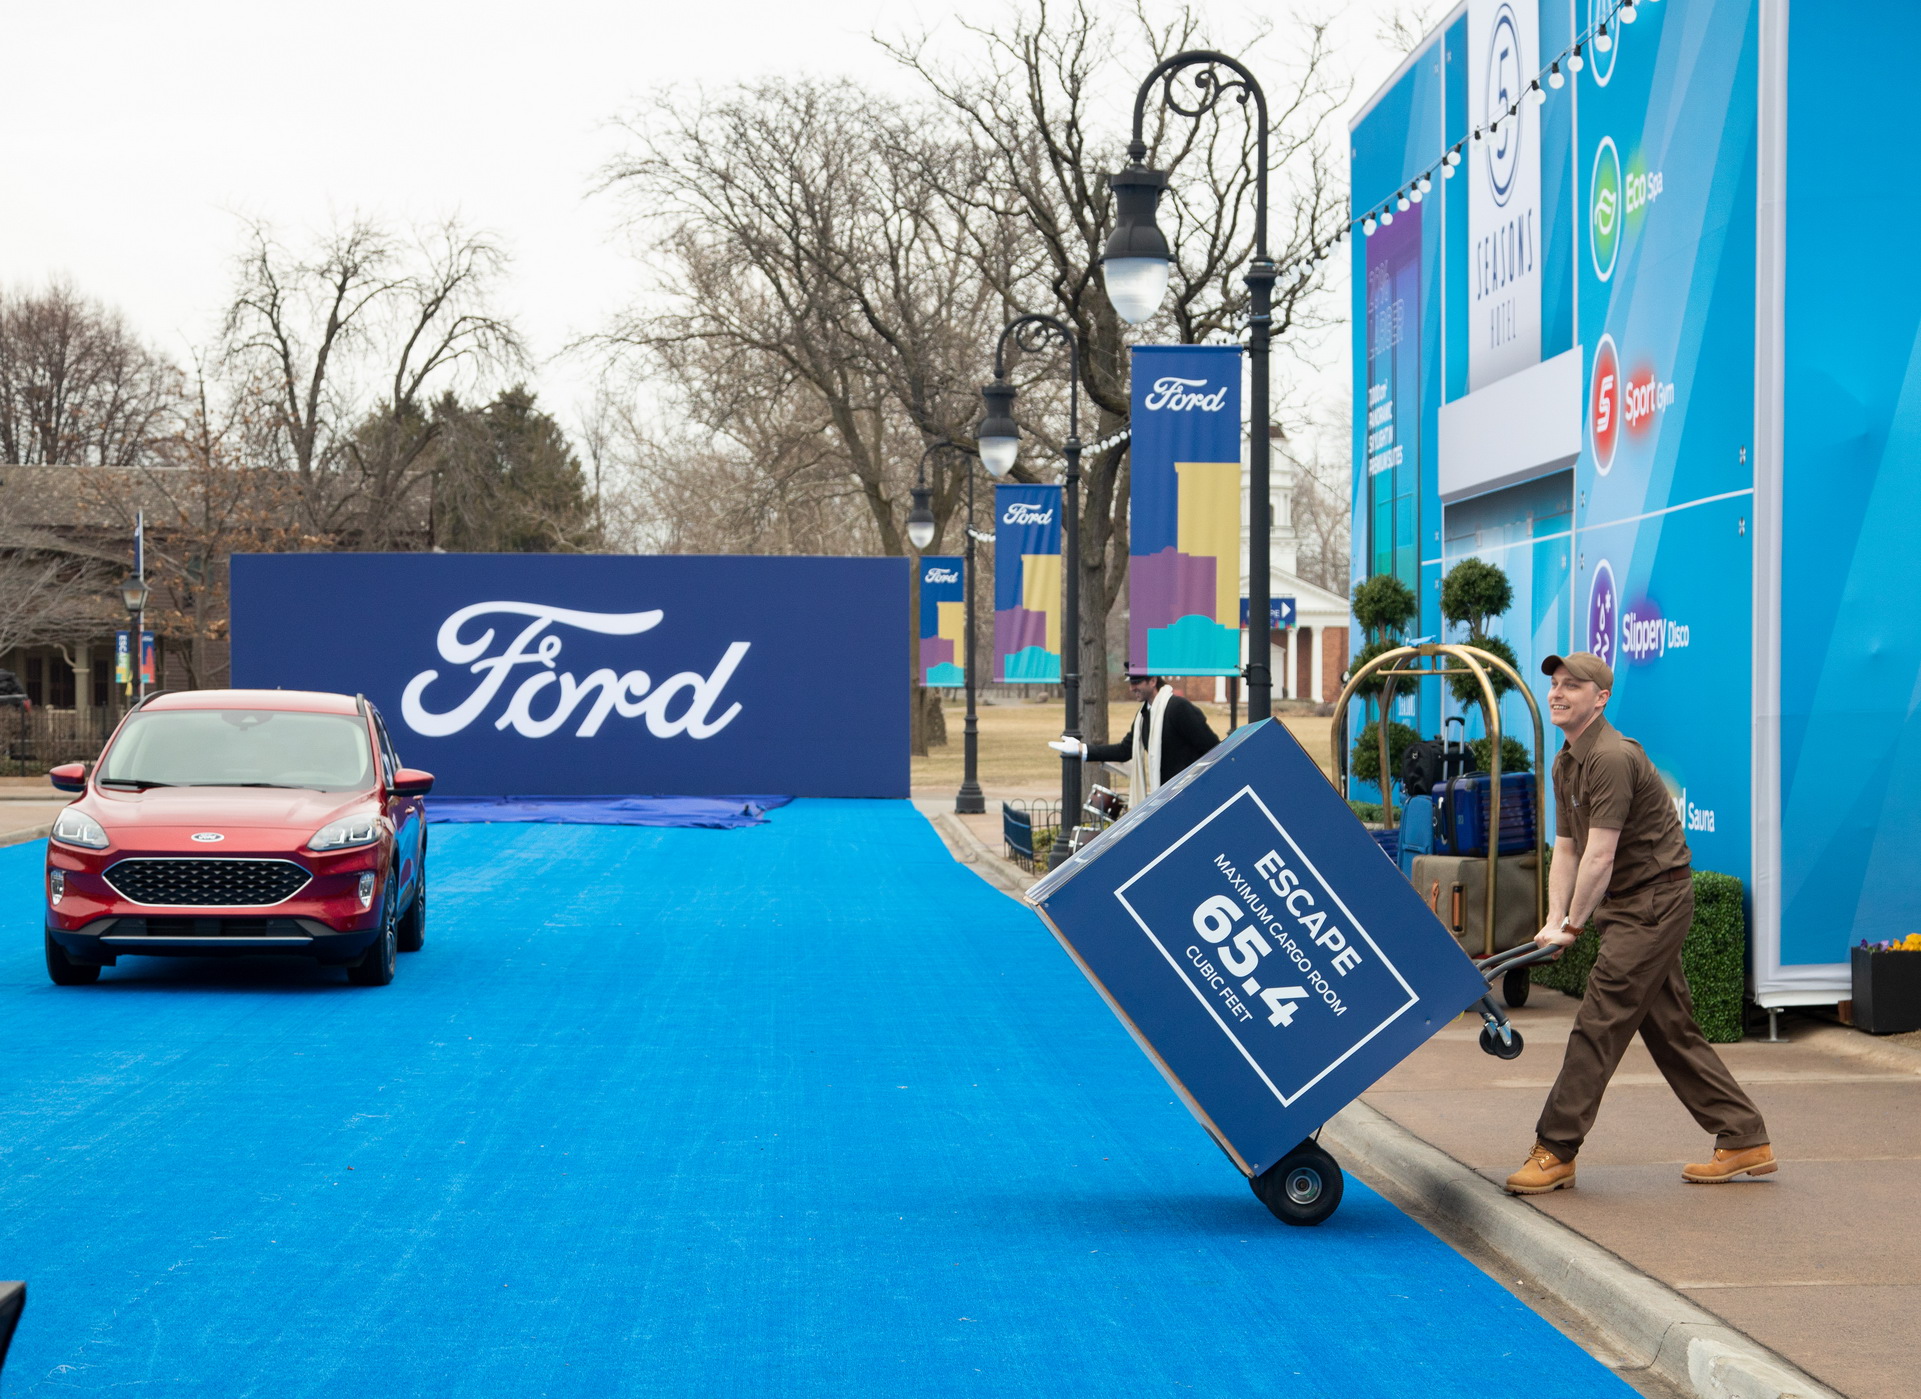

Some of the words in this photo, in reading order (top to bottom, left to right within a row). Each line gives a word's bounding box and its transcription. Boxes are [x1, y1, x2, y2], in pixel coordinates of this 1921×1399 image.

[1625, 172, 1647, 214] Eco
[1647, 171, 1663, 203] Spa
[1477, 208, 1532, 301] SEASONS
[1491, 298, 1516, 349] HOTEL
[1145, 377, 1228, 412] Ford
[1625, 373, 1656, 427] Sport
[1656, 382, 1675, 413] Gym
[1003, 503, 1053, 526] Ford
[924, 567, 959, 584] Ford
[1622, 611, 1667, 660] Slippery
[1668, 620, 1690, 649] Disco
[401, 600, 751, 739] Ford
[1688, 801, 1716, 833] Sauna
[1213, 853, 1274, 925] MAXIMUM
[1269, 922, 1312, 972] CARGO
[1307, 970, 1348, 1017] ROOM
[1254, 849, 1363, 977] ESCAPE
[1186, 945, 1224, 990] CUBIC
[1219, 986, 1253, 1022] FEET
[1192, 894, 1310, 1028] 65.4
